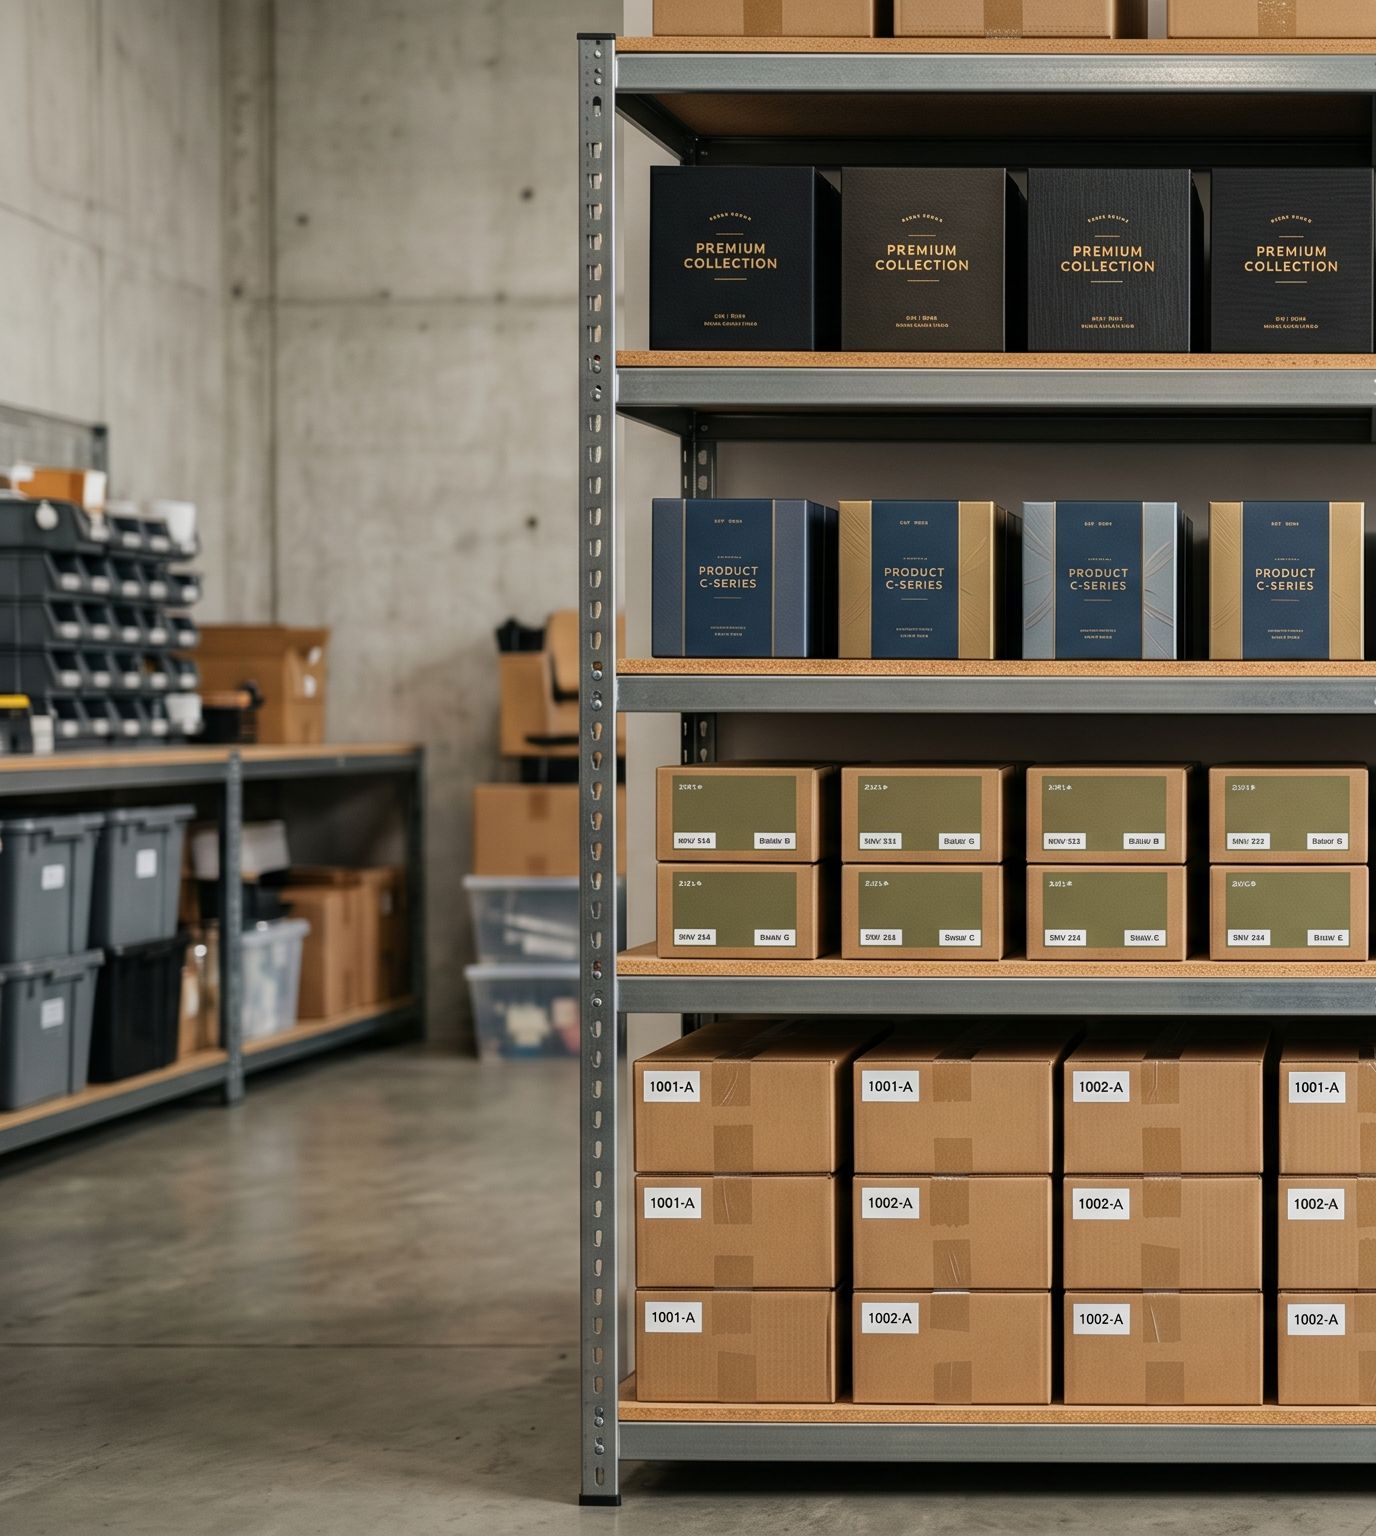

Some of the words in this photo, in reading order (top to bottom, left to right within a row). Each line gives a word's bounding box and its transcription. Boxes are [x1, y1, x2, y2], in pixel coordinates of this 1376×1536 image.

[696, 242, 766, 254] PREMIUM
[888, 244, 956, 256] PREMIUM
[1074, 246, 1142, 258] PREMIUM
[1256, 246, 1326, 256] PREMIUM
[684, 258, 776, 270] COLLECTION
[876, 260, 968, 270] COLLECTION
[1060, 260, 1154, 272] COLLECTION
[1244, 260, 1338, 272] COLLECTION
[700, 566, 758, 576] PRODUCT
[884, 568, 944, 578] PRODUCT
[1068, 568, 1128, 578] PRODUCT
[1256, 568, 1316, 578] PRODUCT
[700, 578, 756, 588] C-SERIES
[886, 580, 942, 590] C-SERIES
[1070, 580, 1126, 590] C-SERIES
[1256, 582, 1314, 590] C-SERIES
[650, 1080, 694, 1092] 1001-A
[868, 1080, 914, 1092] 1001-A
[1080, 1080, 1124, 1092] 1002-A
[1296, 1082, 1340, 1094] 1001-A
[650, 1196, 696, 1208] 1001-A
[868, 1196, 912, 1208] 1002-A
[1080, 1198, 1124, 1210] 1002-A
[1294, 1198, 1338, 1210] 1002-A
[652, 1312, 696, 1324] 1001-A
[868, 1312, 912, 1324] 1002-A
[1080, 1314, 1124, 1324] 1002-A
[1294, 1314, 1338, 1326] 1002-A
